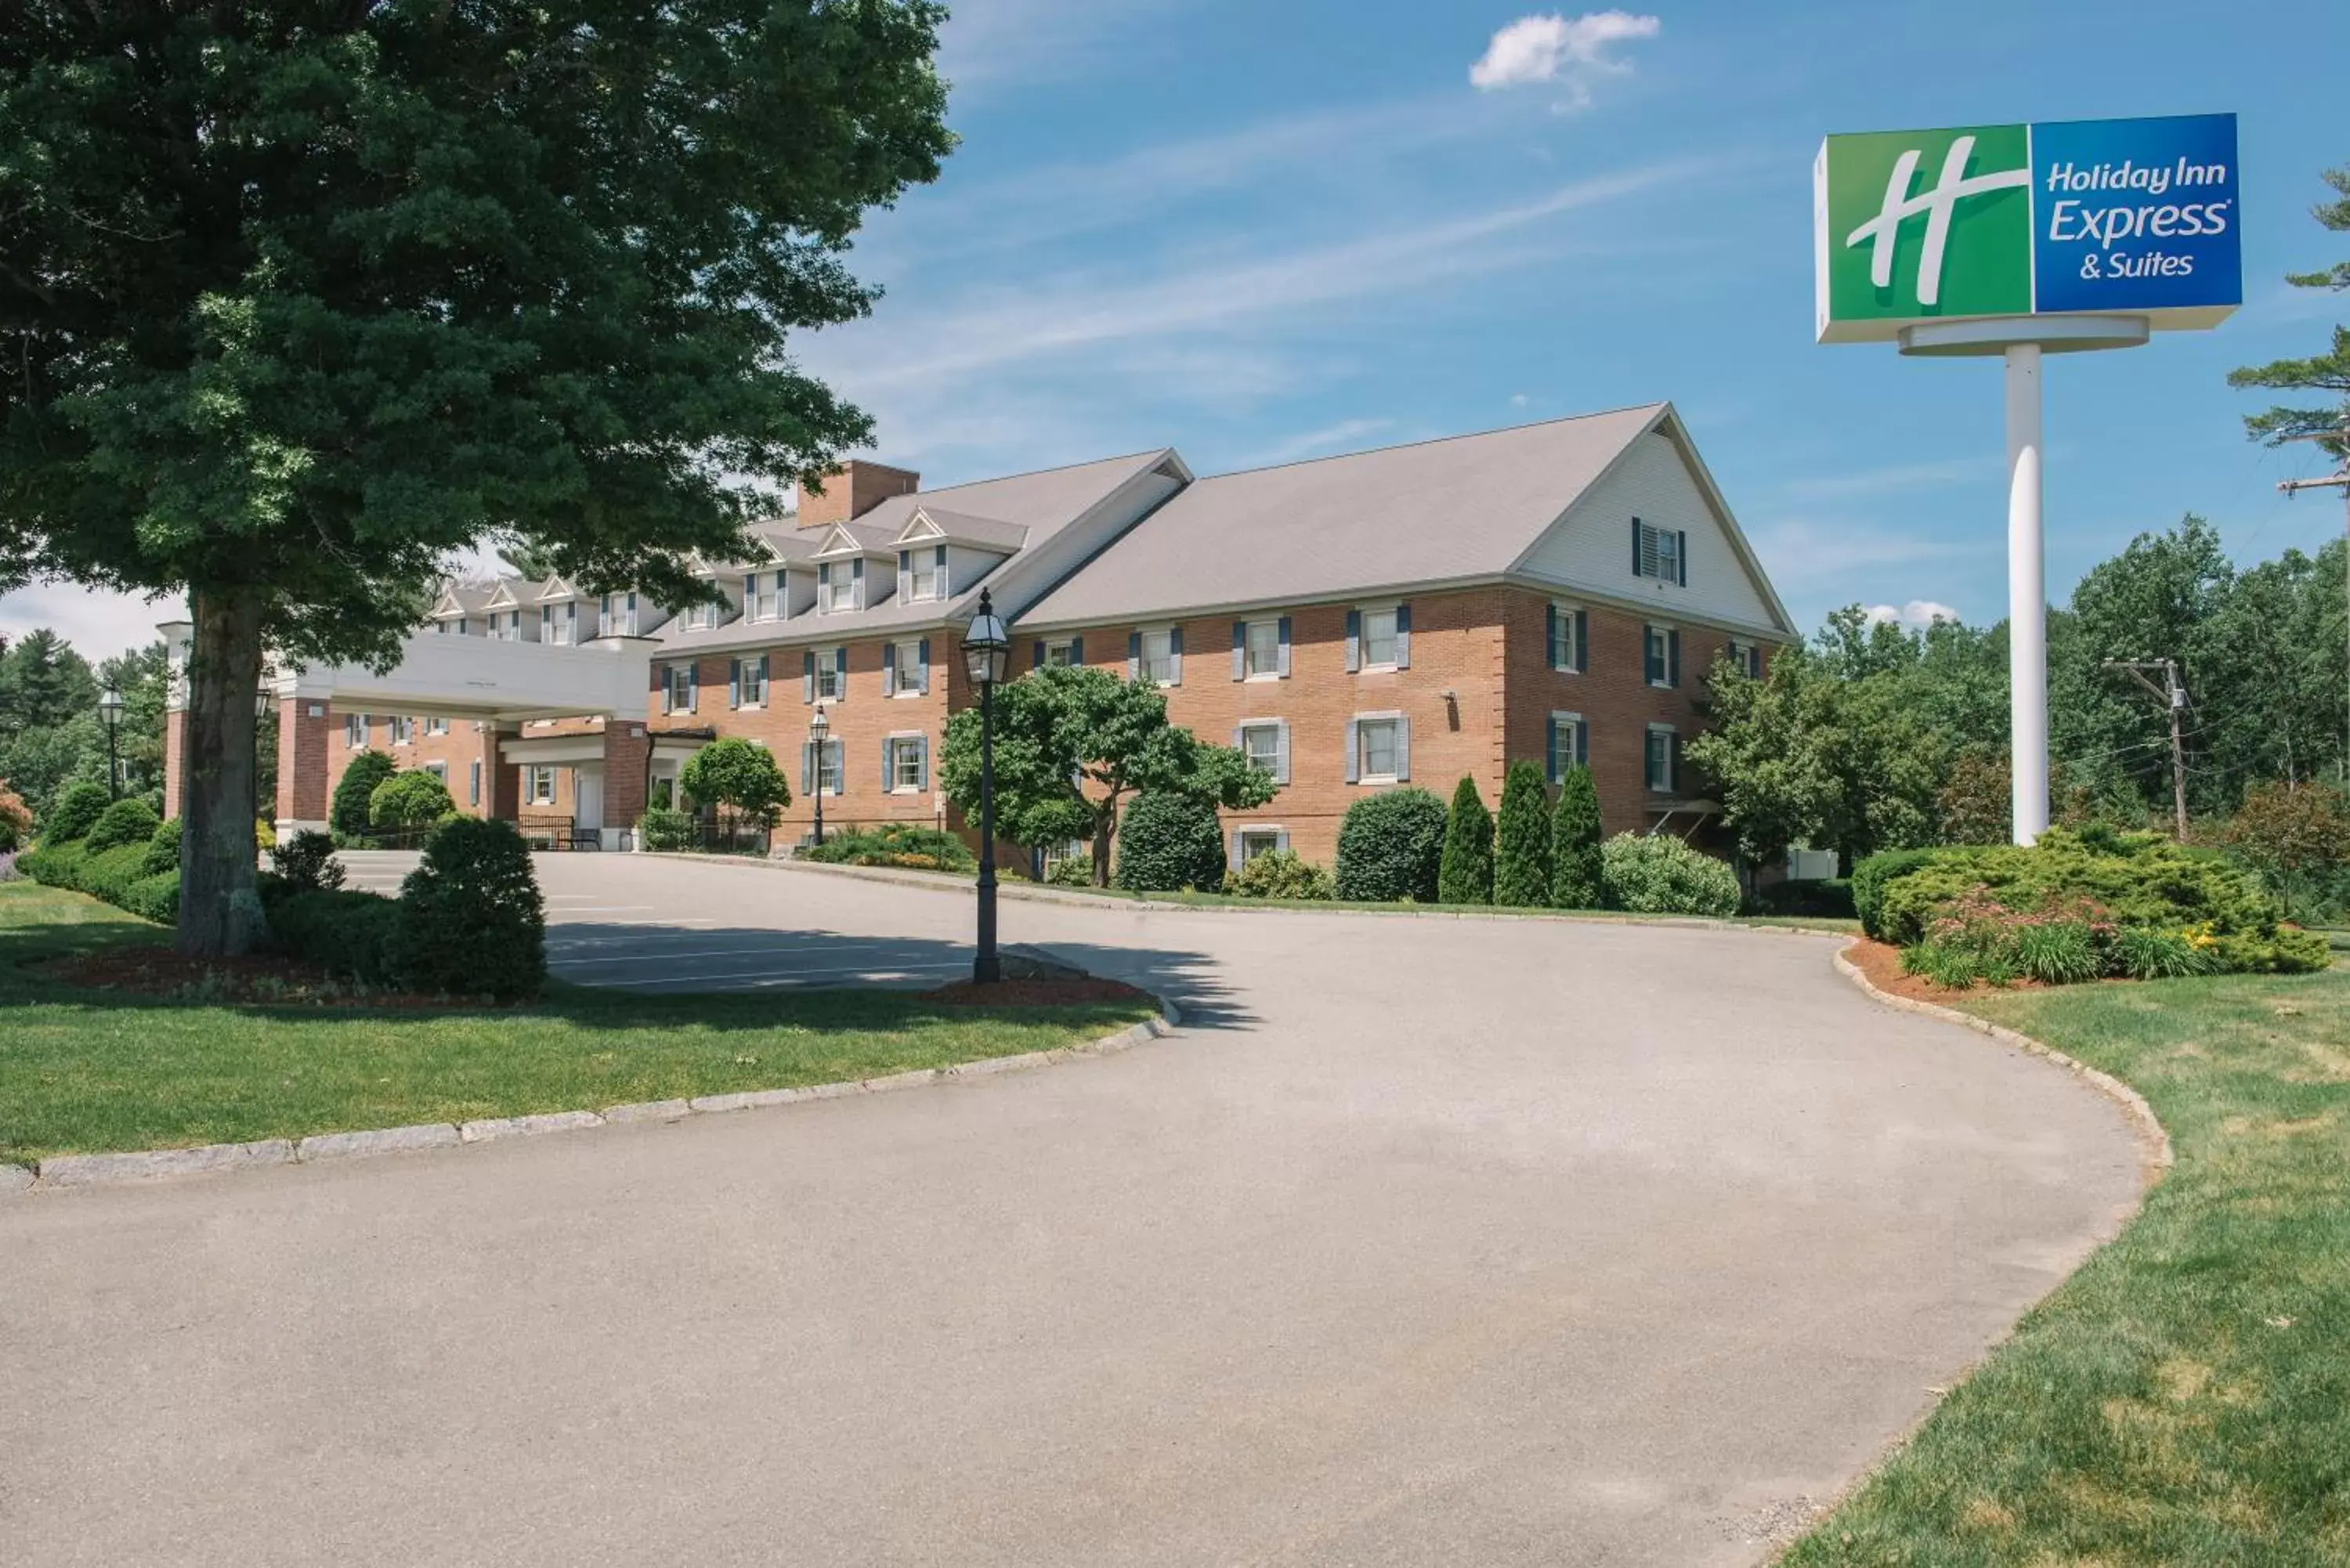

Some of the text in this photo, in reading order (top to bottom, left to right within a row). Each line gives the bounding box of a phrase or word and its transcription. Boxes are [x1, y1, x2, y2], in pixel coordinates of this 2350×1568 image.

[2047, 157, 2225, 194] Holiday Inn
[1846, 135, 2030, 305] H
[2048, 200, 2227, 250] Express
[2080, 251, 2194, 279] & Suites
